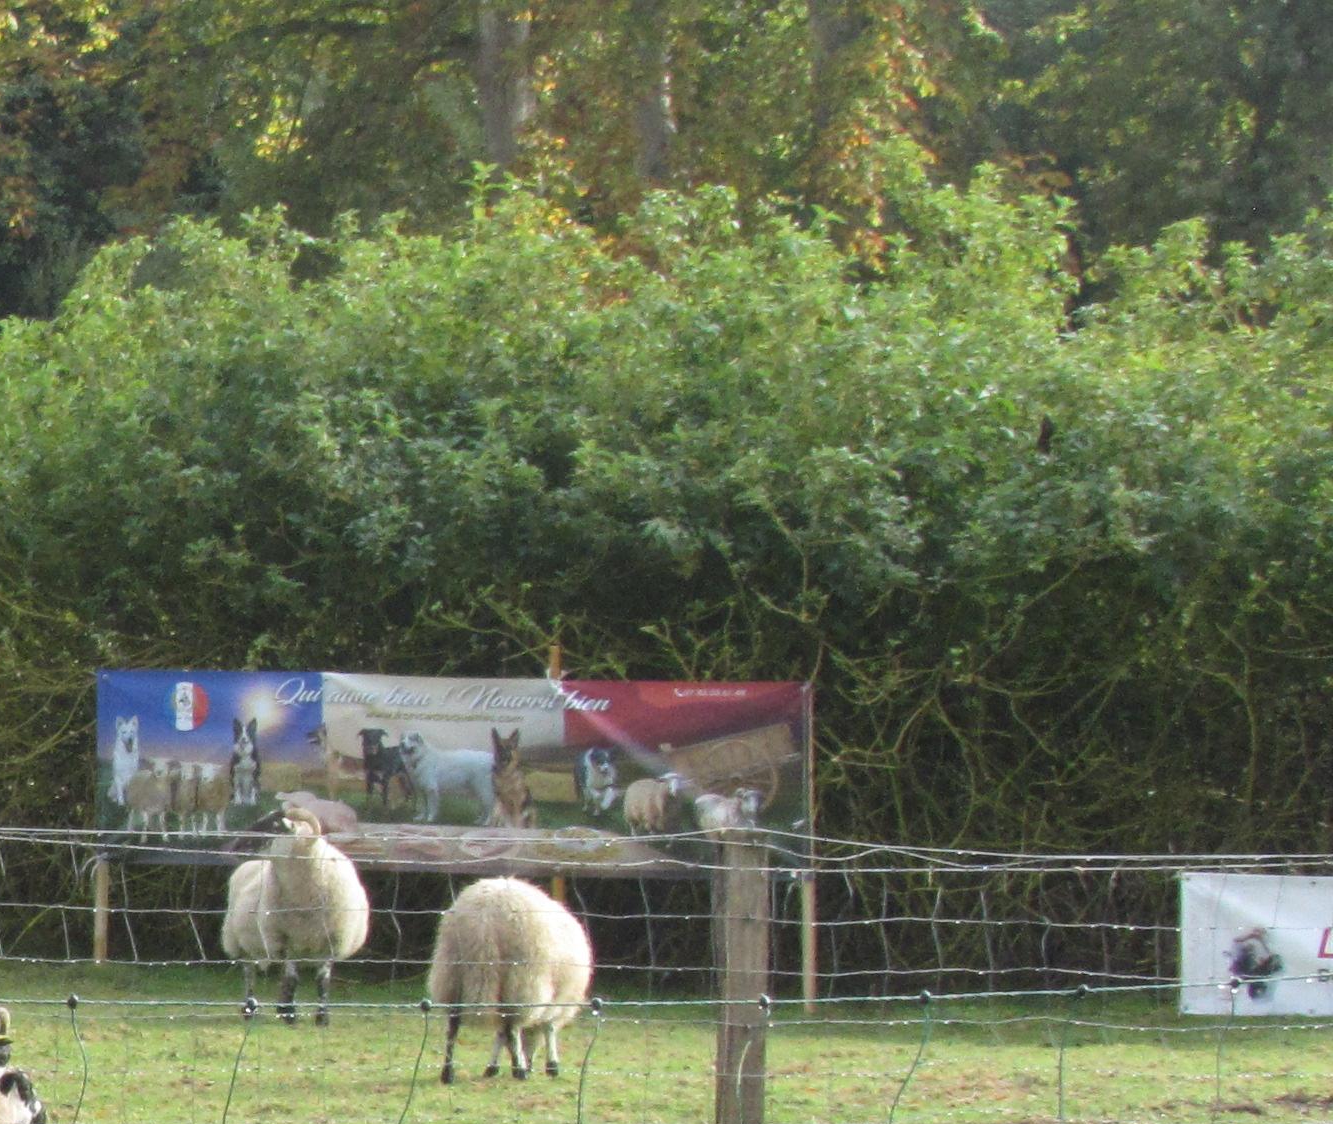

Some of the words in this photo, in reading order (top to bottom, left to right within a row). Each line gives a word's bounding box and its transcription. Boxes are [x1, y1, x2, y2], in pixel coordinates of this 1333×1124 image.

[275, 677, 323, 707] Qui
[383, 684, 431, 706] bien
[563, 690, 612, 711] bien
